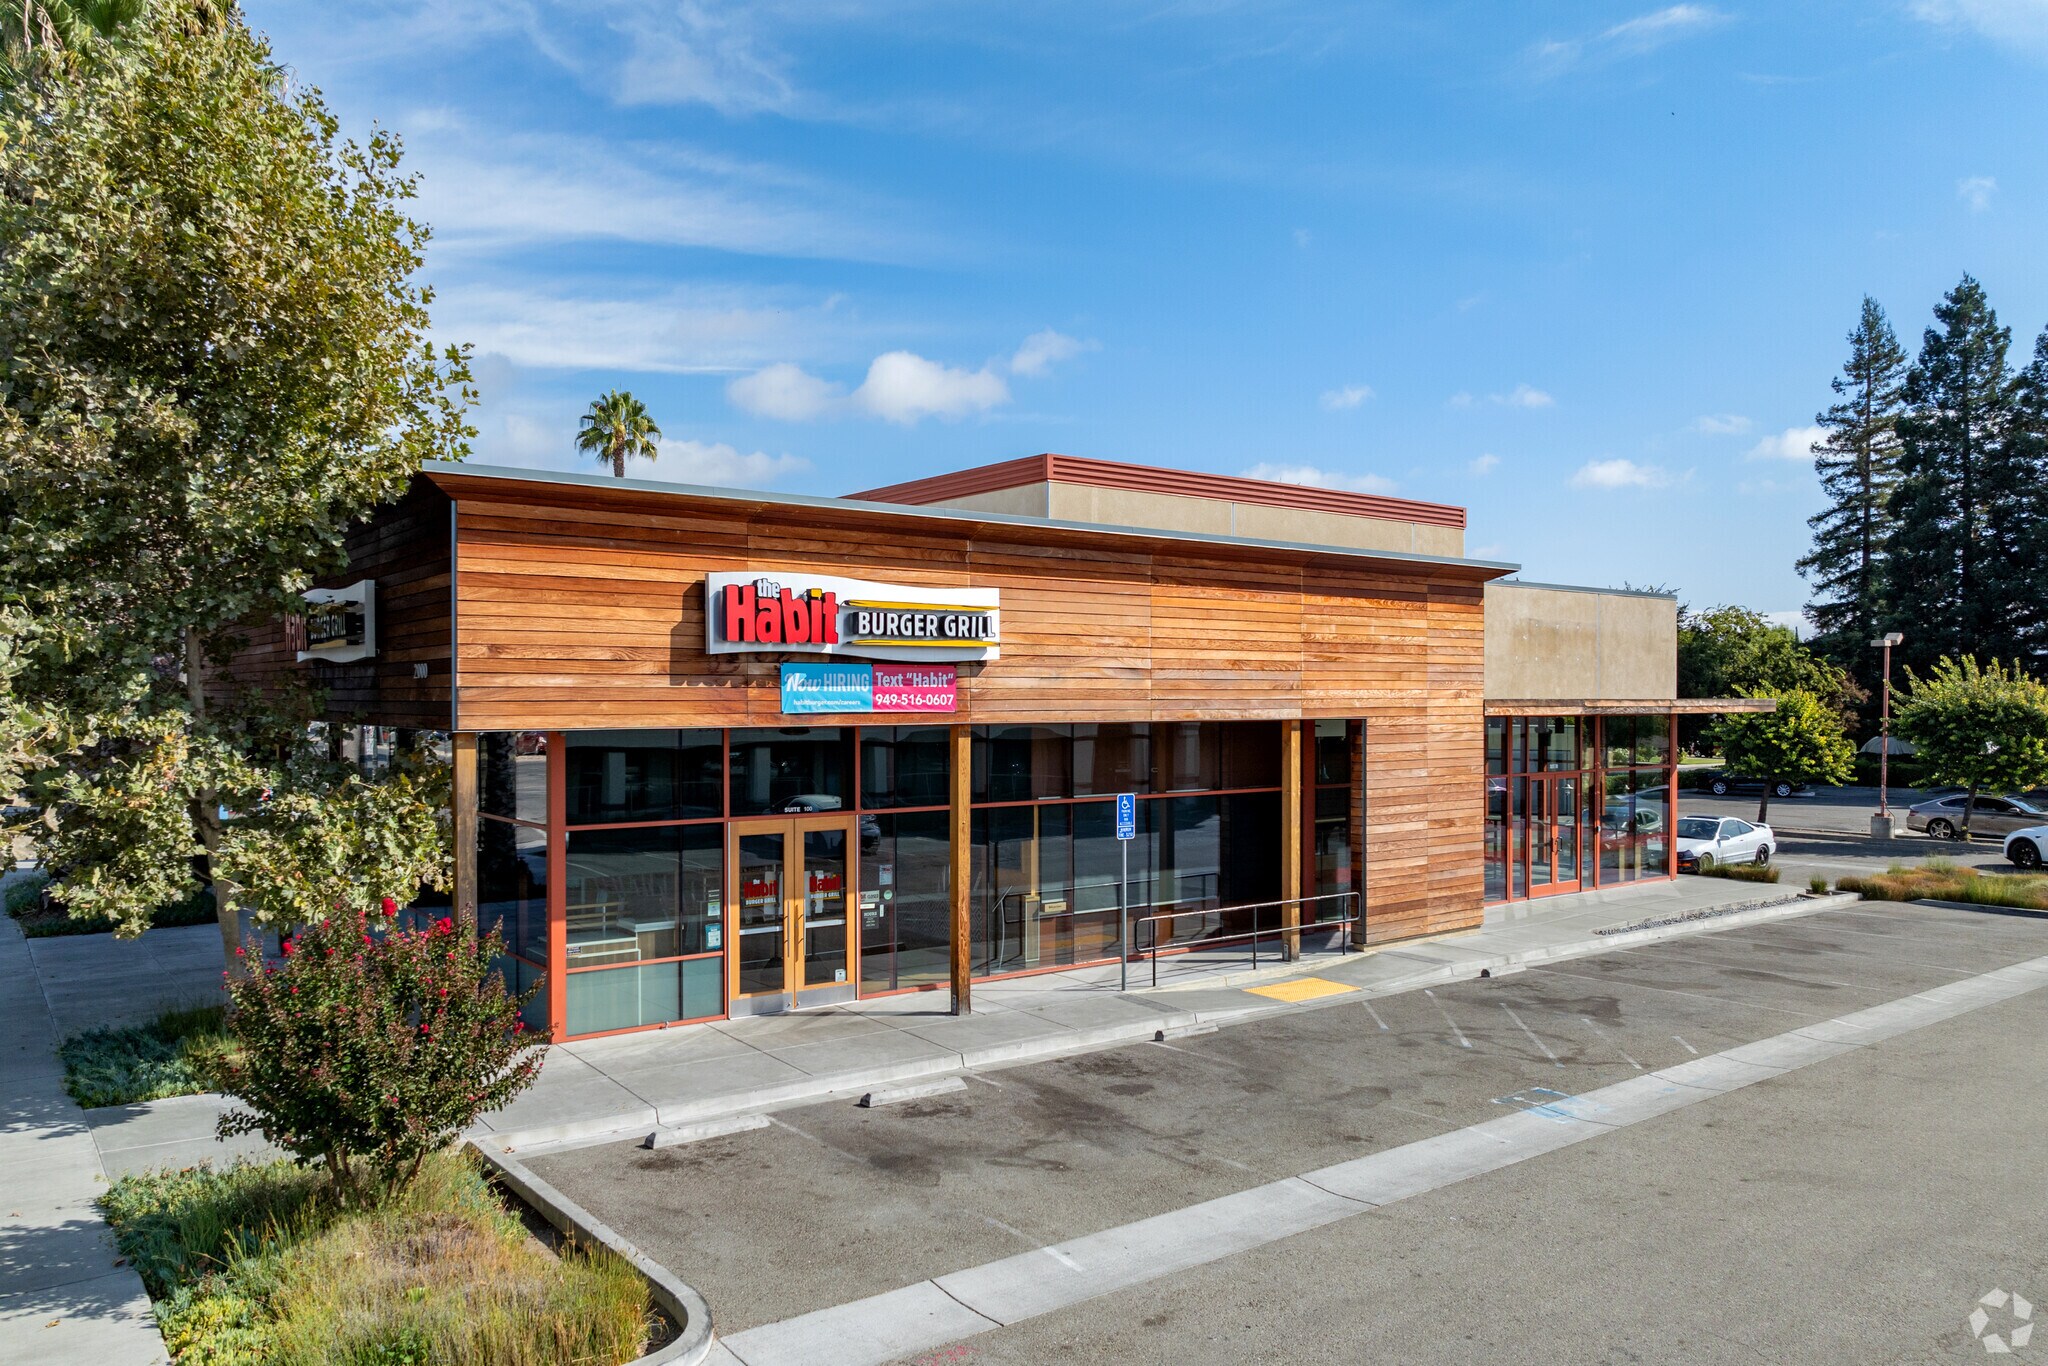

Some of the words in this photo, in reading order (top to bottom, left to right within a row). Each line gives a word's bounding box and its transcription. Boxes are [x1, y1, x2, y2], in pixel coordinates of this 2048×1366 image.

[756, 578, 781, 598] the
[725, 585, 839, 645] Habit
[857, 611, 938, 637] BURGER
[944, 614, 996, 638] GRILL
[784, 672, 822, 692] Now
[823, 672, 870, 692] HIRING
[875, 672, 903, 688] Text
[906, 672, 954, 688] "Habit"
[875, 693, 954, 707] 949-516-0607
[743, 880, 778, 899] Habit
